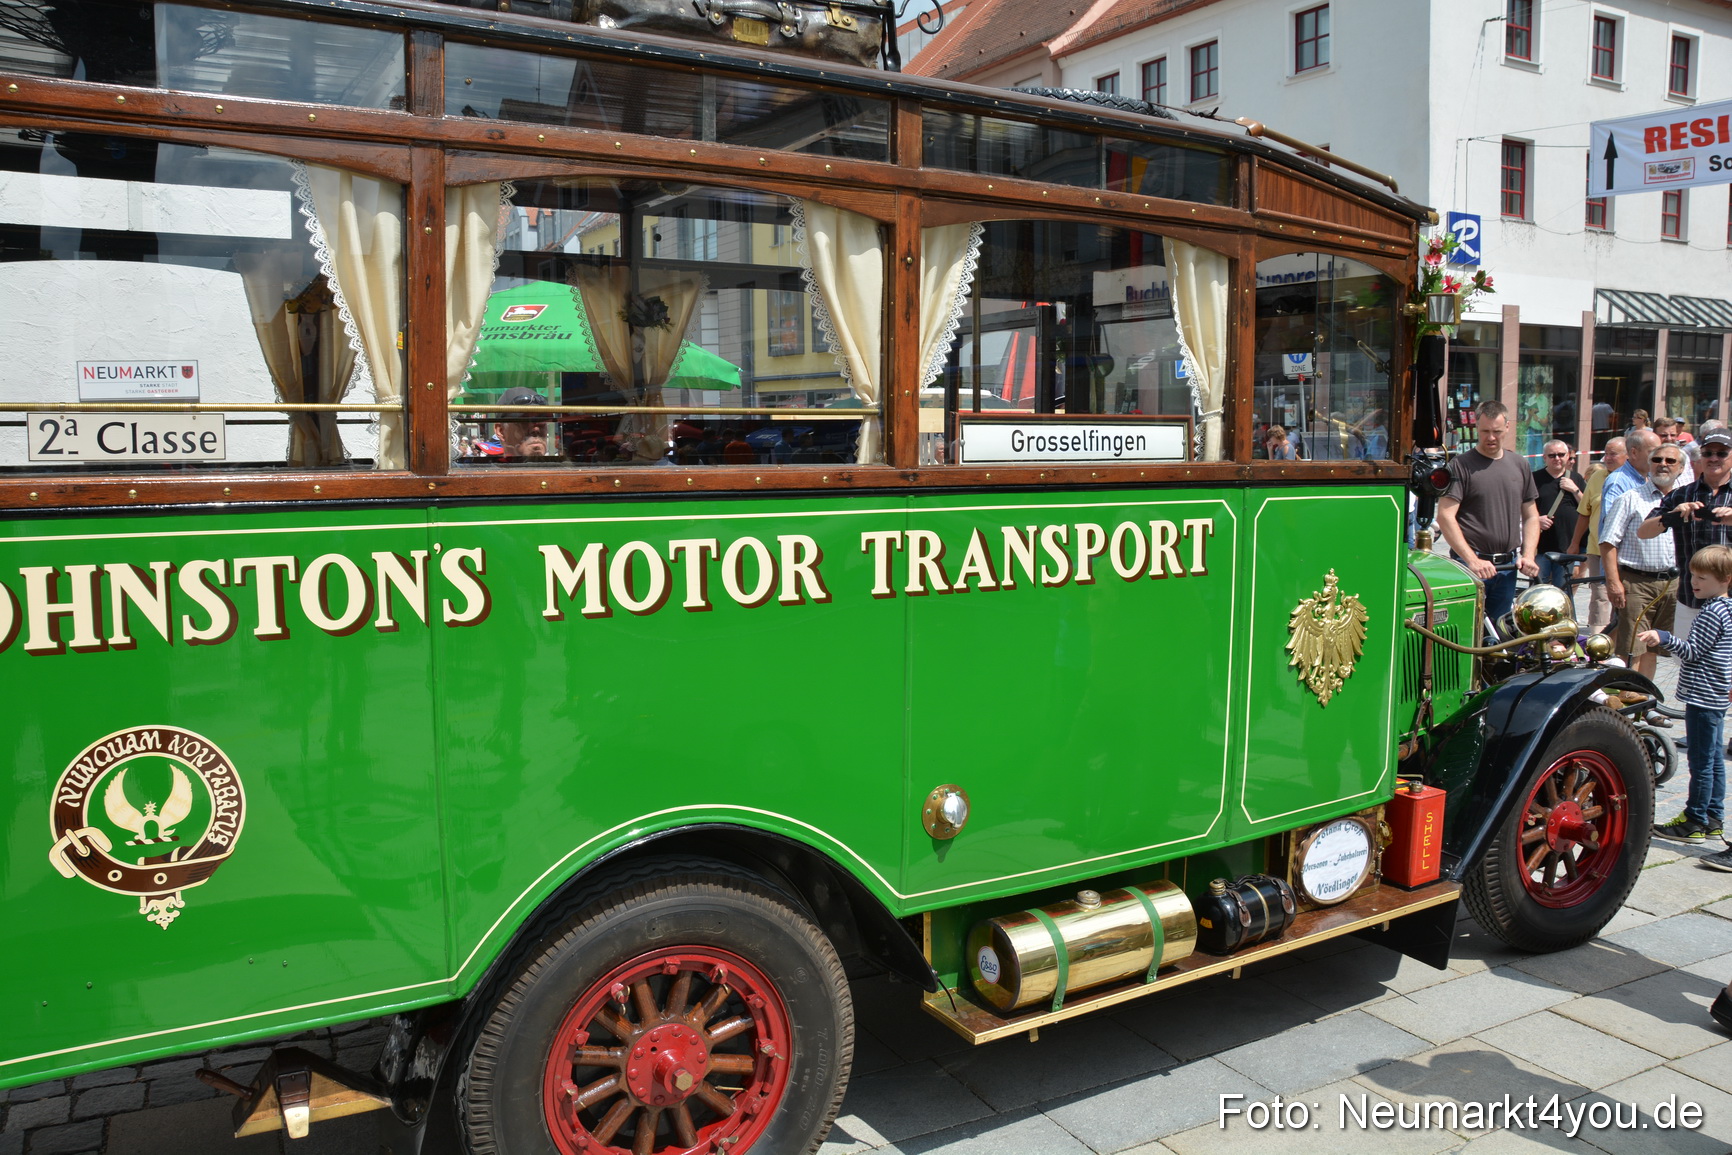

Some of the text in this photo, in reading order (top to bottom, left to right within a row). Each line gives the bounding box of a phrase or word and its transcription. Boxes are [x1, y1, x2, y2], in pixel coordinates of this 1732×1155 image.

[1643, 114, 1730, 154] RESI
[480, 324, 561, 332] umarkter
[484, 331, 573, 341] msbräu
[83, 365, 178, 380] NEUMARKT
[1291, 364, 1306, 373] ZONE
[96, 421, 218, 455] Classe
[1011, 429, 1147, 457] Grosselfingen
[0, 517, 1216, 657] HNSTON'S MOTOR TRANSPORT
[168, 734, 216, 768] NON
[1422, 812, 1434, 870] SHELL
[980, 955, 998, 975] Esso
